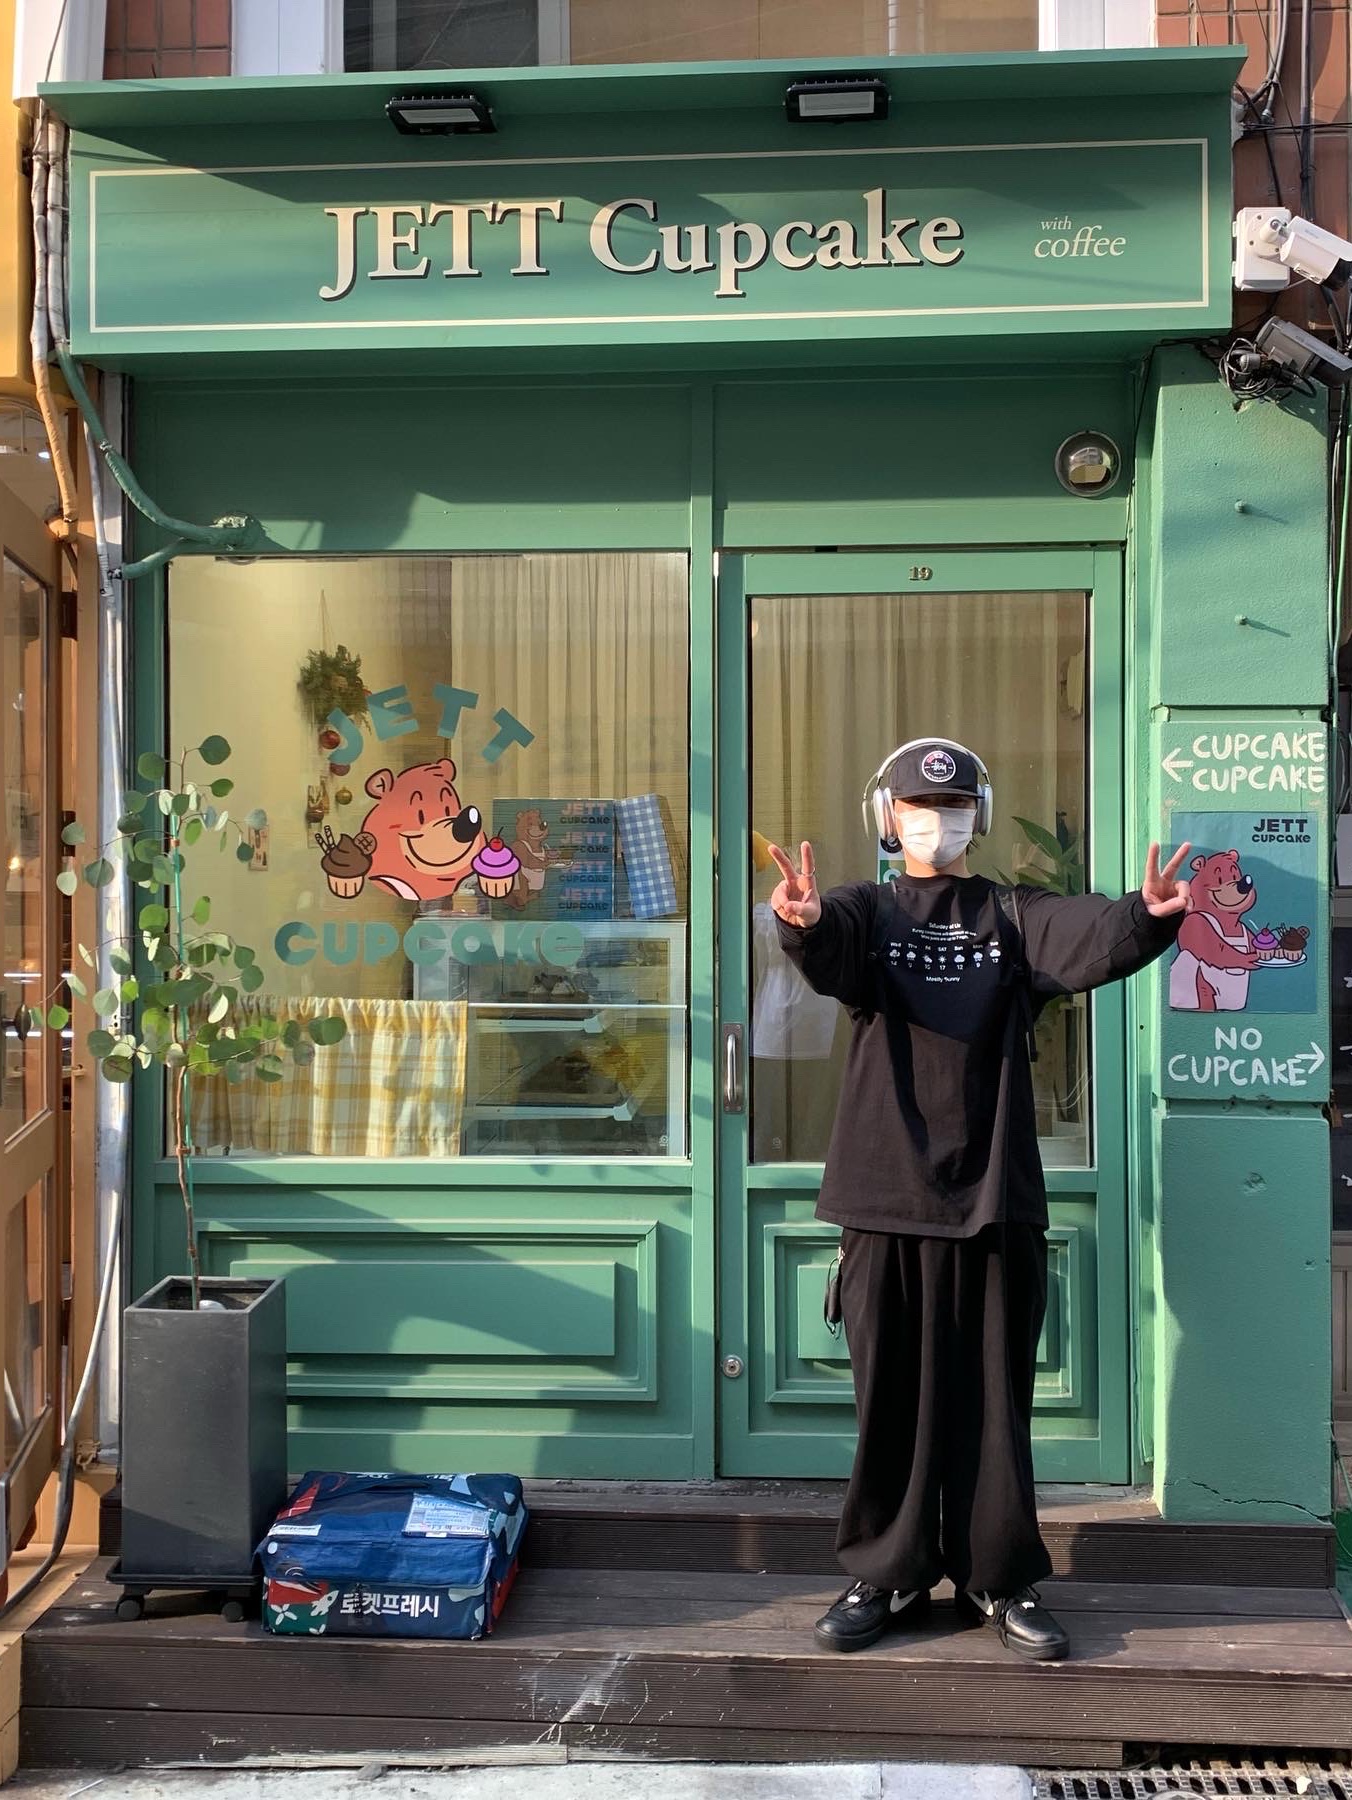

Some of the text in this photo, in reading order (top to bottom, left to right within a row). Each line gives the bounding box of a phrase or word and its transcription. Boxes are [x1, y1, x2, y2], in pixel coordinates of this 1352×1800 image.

[1040, 215, 1072, 230] with
[318, 187, 964, 301] JETT Cupcake
[1034, 225, 1126, 257] coffee
[909, 566, 934, 581] 19
[326, 684, 535, 765] JETT
[1192, 732, 1326, 762] CUPCAKE
[1192, 764, 1326, 793] CUPCAKE
[561, 803, 607, 816] JETT
[560, 831, 606, 844] JETT
[1253, 819, 1308, 833] JETT
[1215, 1026, 1262, 1051] NO
[1168, 1053, 1308, 1087] CUPCAKE
[340, 1592, 440, 1618] 로켓프레시
